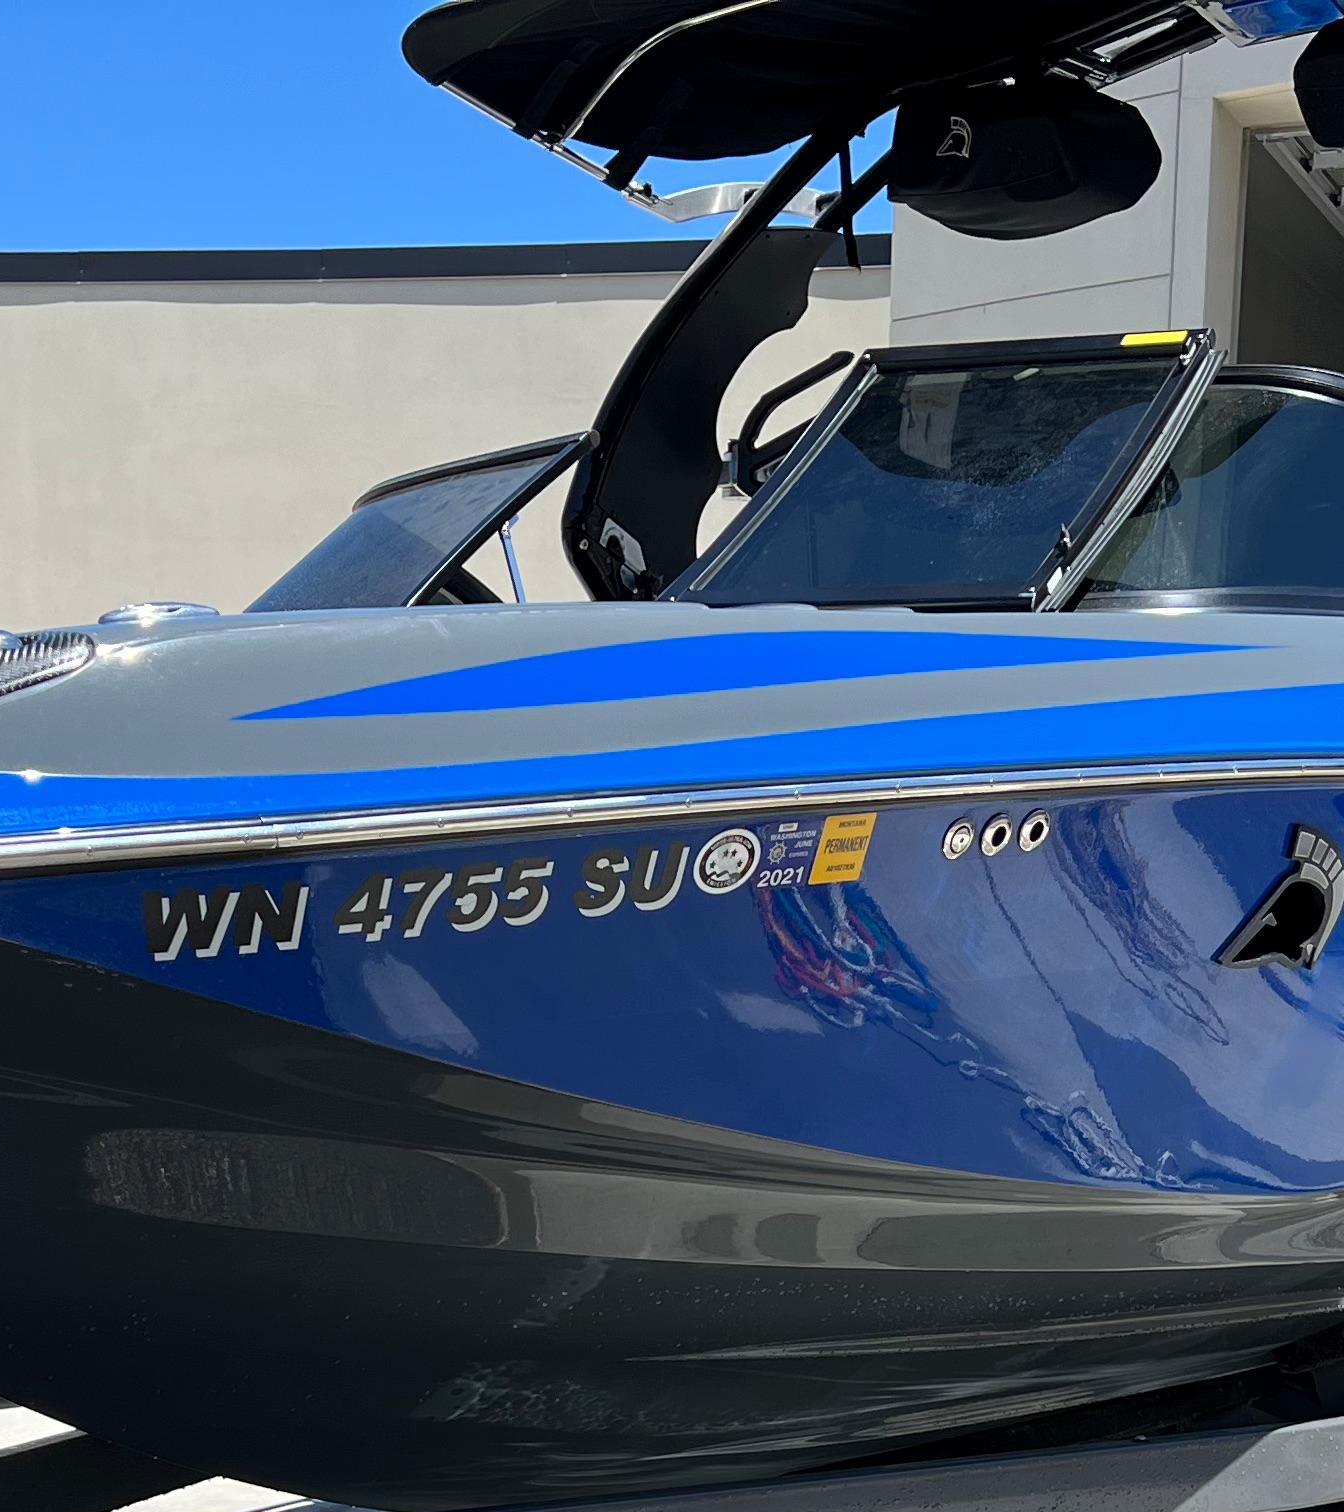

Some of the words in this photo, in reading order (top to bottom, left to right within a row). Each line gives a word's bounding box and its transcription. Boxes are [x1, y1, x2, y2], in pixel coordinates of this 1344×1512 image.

[770, 830, 817, 841] WASHINGTON
[824, 835, 869, 854] PERMANENT
[757, 866, 805, 888] 2021
[143, 879, 309, 962] WN
[334, 856, 554, 942] 4755
[573, 842, 691, 917] SU
